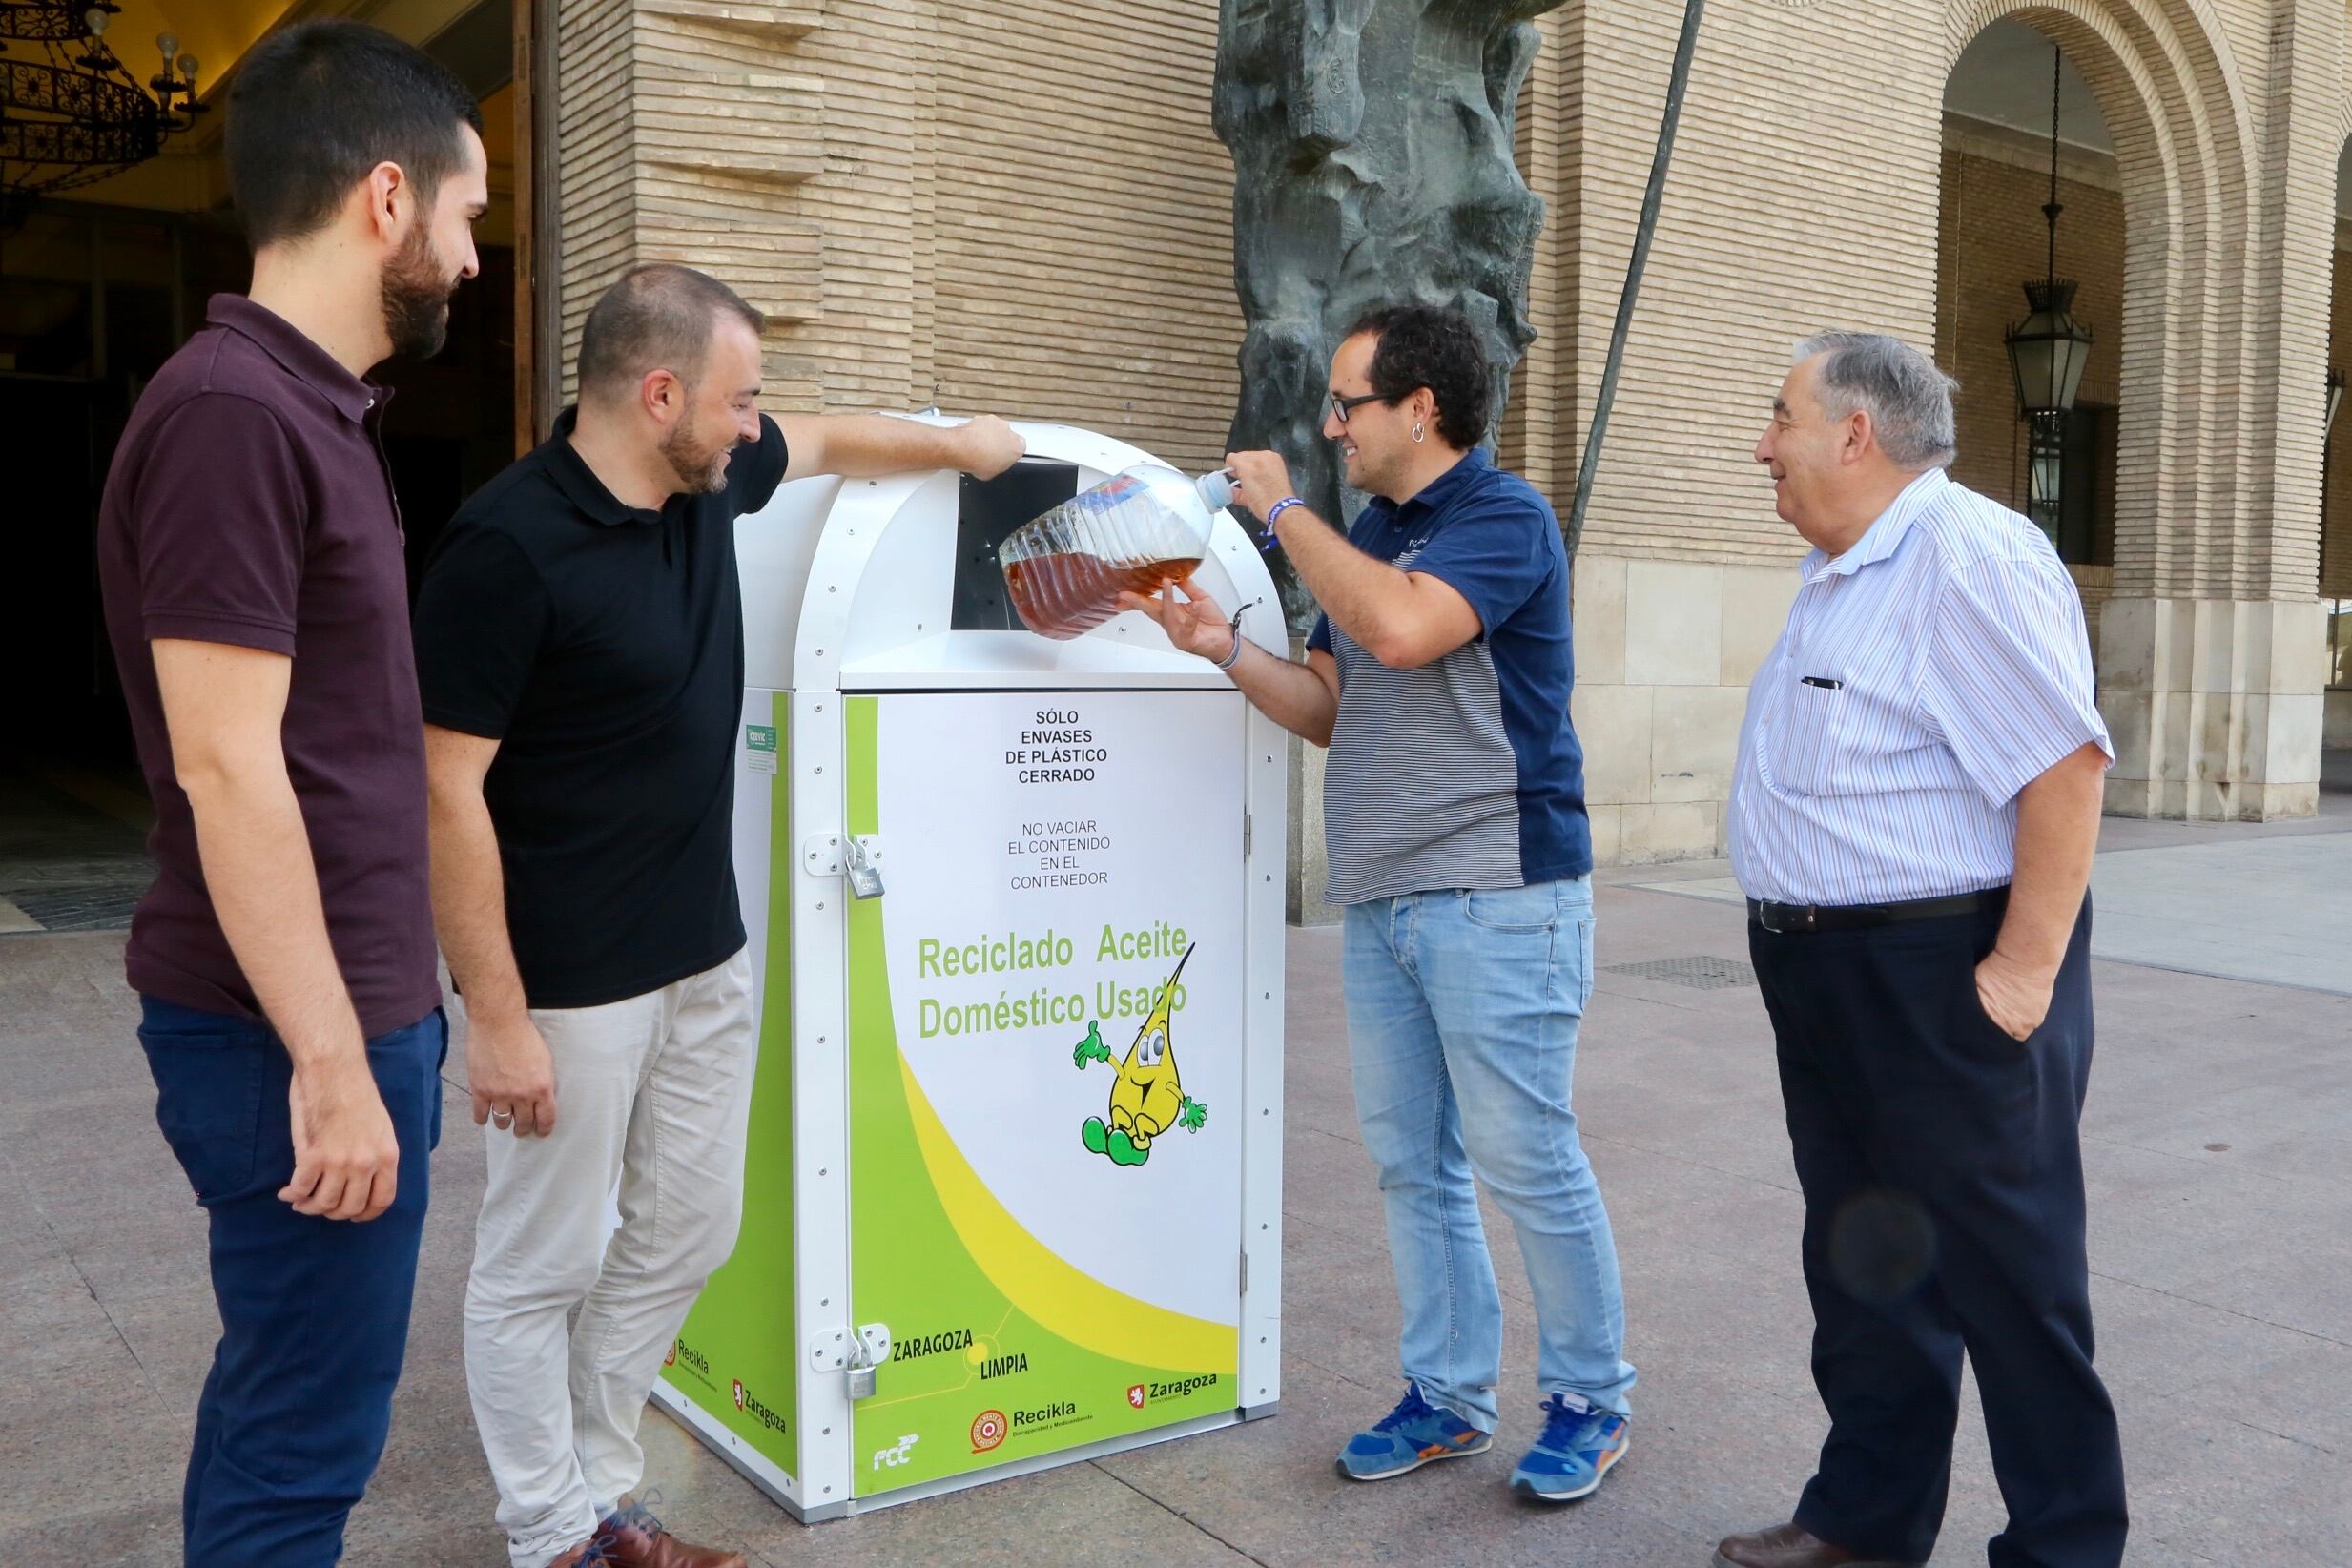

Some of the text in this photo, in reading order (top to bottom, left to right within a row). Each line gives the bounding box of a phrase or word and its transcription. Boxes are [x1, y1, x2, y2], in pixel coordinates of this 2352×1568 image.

[1036, 708, 1079, 725] SÓLO
[1021, 730, 1092, 744] ENVASES
[1005, 747, 1107, 764] DE PLÁSTICO
[1019, 768, 1095, 783] CERRADO
[1022, 820, 1097, 836] NO VACIAR
[1008, 837, 1110, 855] EL CONTENIDO
[1040, 856, 1080, 870] EN EL
[1011, 872, 1108, 890] CONTENEDOR
[918, 920, 1187, 979] Reciclado Aceite
[919, 976, 1186, 1039] Doméstico Usado
[678, 1338, 709, 1374] Recikla
[893, 1328, 974, 1362] ZARAGOZA
[980, 1353, 1028, 1380] LIMPIA
[1150, 1373, 1217, 1399] Zaragoza
[745, 1390, 786, 1434] Zaragoza
[1013, 1401, 1076, 1428] Recikla
